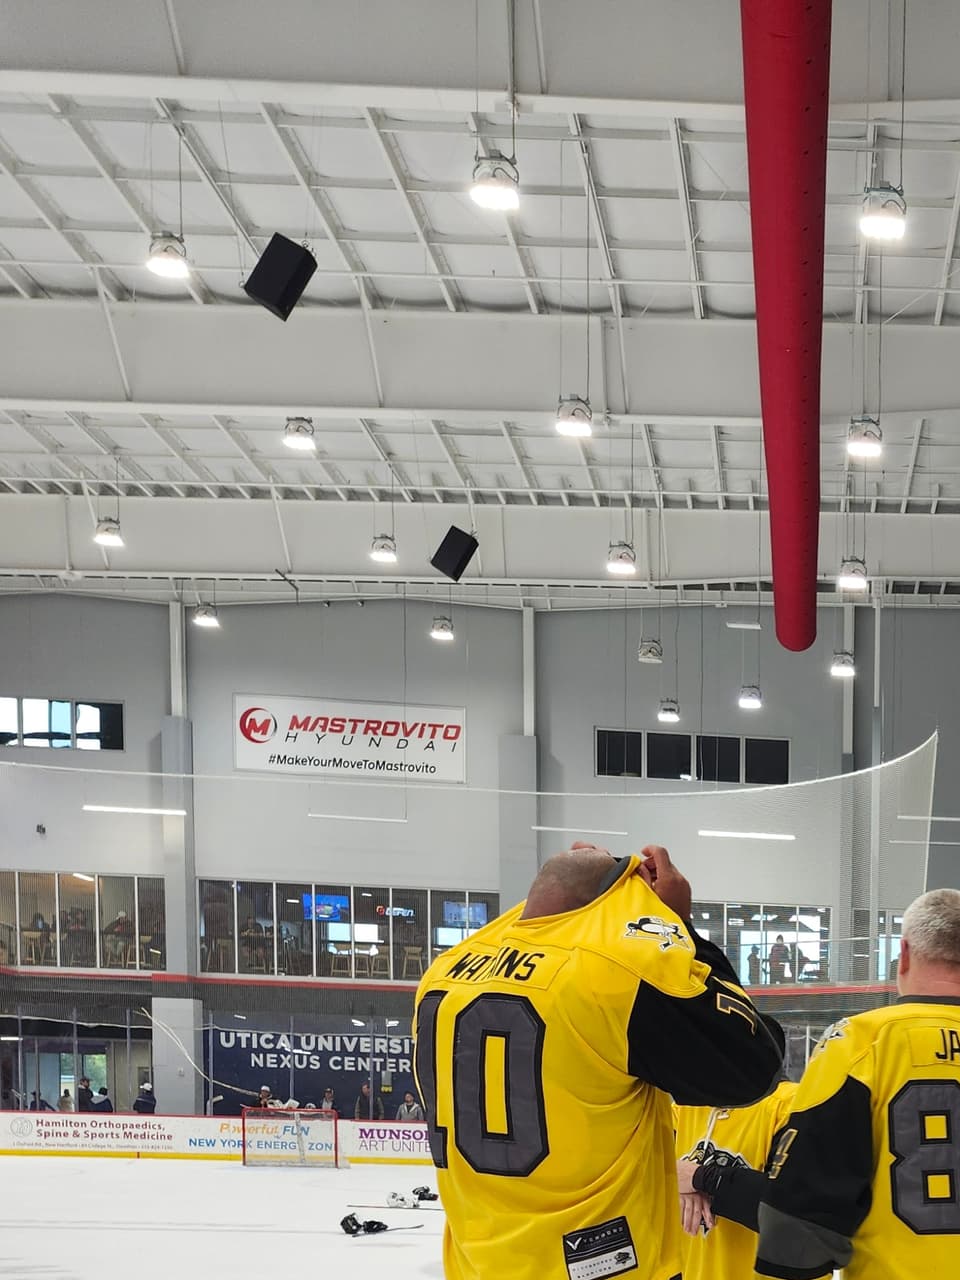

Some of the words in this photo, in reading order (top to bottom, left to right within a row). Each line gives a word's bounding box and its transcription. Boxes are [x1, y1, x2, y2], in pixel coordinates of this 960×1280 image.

[288, 714, 462, 741] MASTROVITO
[284, 731, 457, 753] HYUNDAI
[268, 754, 437, 774] #MakeYourMoveToMastrovito
[219, 1031, 293, 1049] UTICA
[300, 1034, 416, 1054] UNIVERSI
[251, 1053, 321, 1070] NEXUS
[329, 1056, 412, 1073] CENTER
[36, 1119, 87, 1129] Hamilton
[90, 1120, 166, 1131] Orthopaedics,
[36, 1129, 69, 1139] Spine
[72, 1130, 80, 1138] &
[84, 1130, 120, 1140] Sports
[123, 1132, 173, 1141] Medicine
[188, 1138, 216, 1148] NEW
[256, 1140, 297, 1150] ENERG
[308, 1142, 334, 1151] ZON
[359, 1139, 388, 1152] ART
